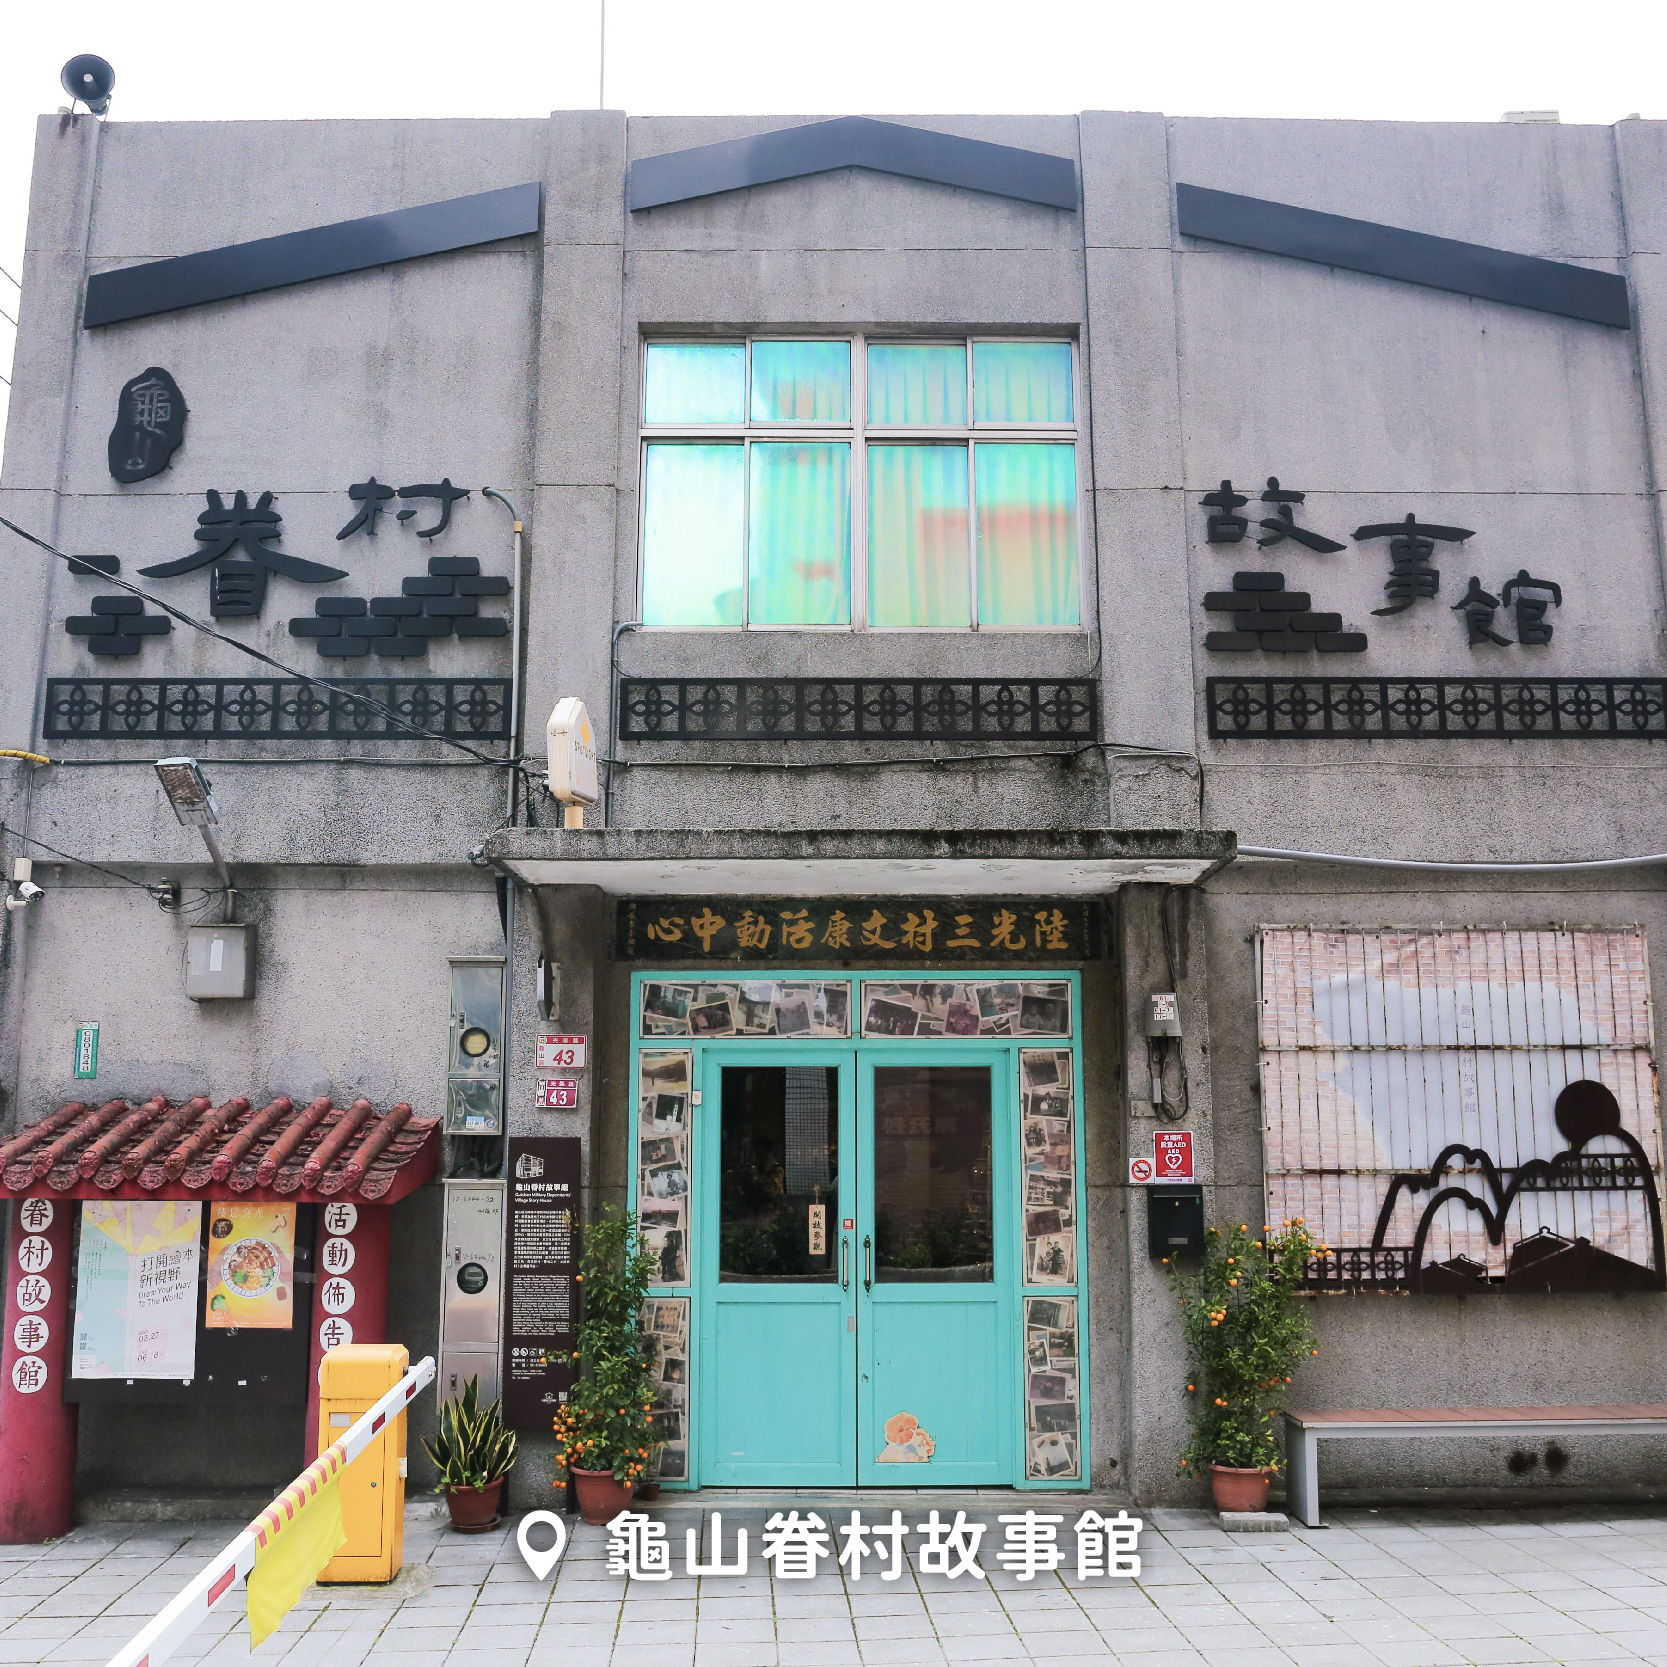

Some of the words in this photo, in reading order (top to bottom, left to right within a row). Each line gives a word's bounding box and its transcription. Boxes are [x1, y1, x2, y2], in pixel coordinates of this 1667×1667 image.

[137, 476, 471, 618] 眷村
[1199, 476, 1562, 646] 故事館
[552, 1049, 575, 1066] 43
[549, 1090, 568, 1106] 43
[141, 1248, 194, 1273] 打開繪本
[139, 1266, 181, 1289] 新視野
[157, 1285, 174, 1294] Your
[175, 1281, 191, 1291] Way
[323, 1203, 351, 1348] 活動佈告
[15, 1199, 50, 1389] 眷村故事館
[138, 1300, 146, 1308] To
[147, 1298, 161, 1306] The
[162, 1291, 184, 1303] World
